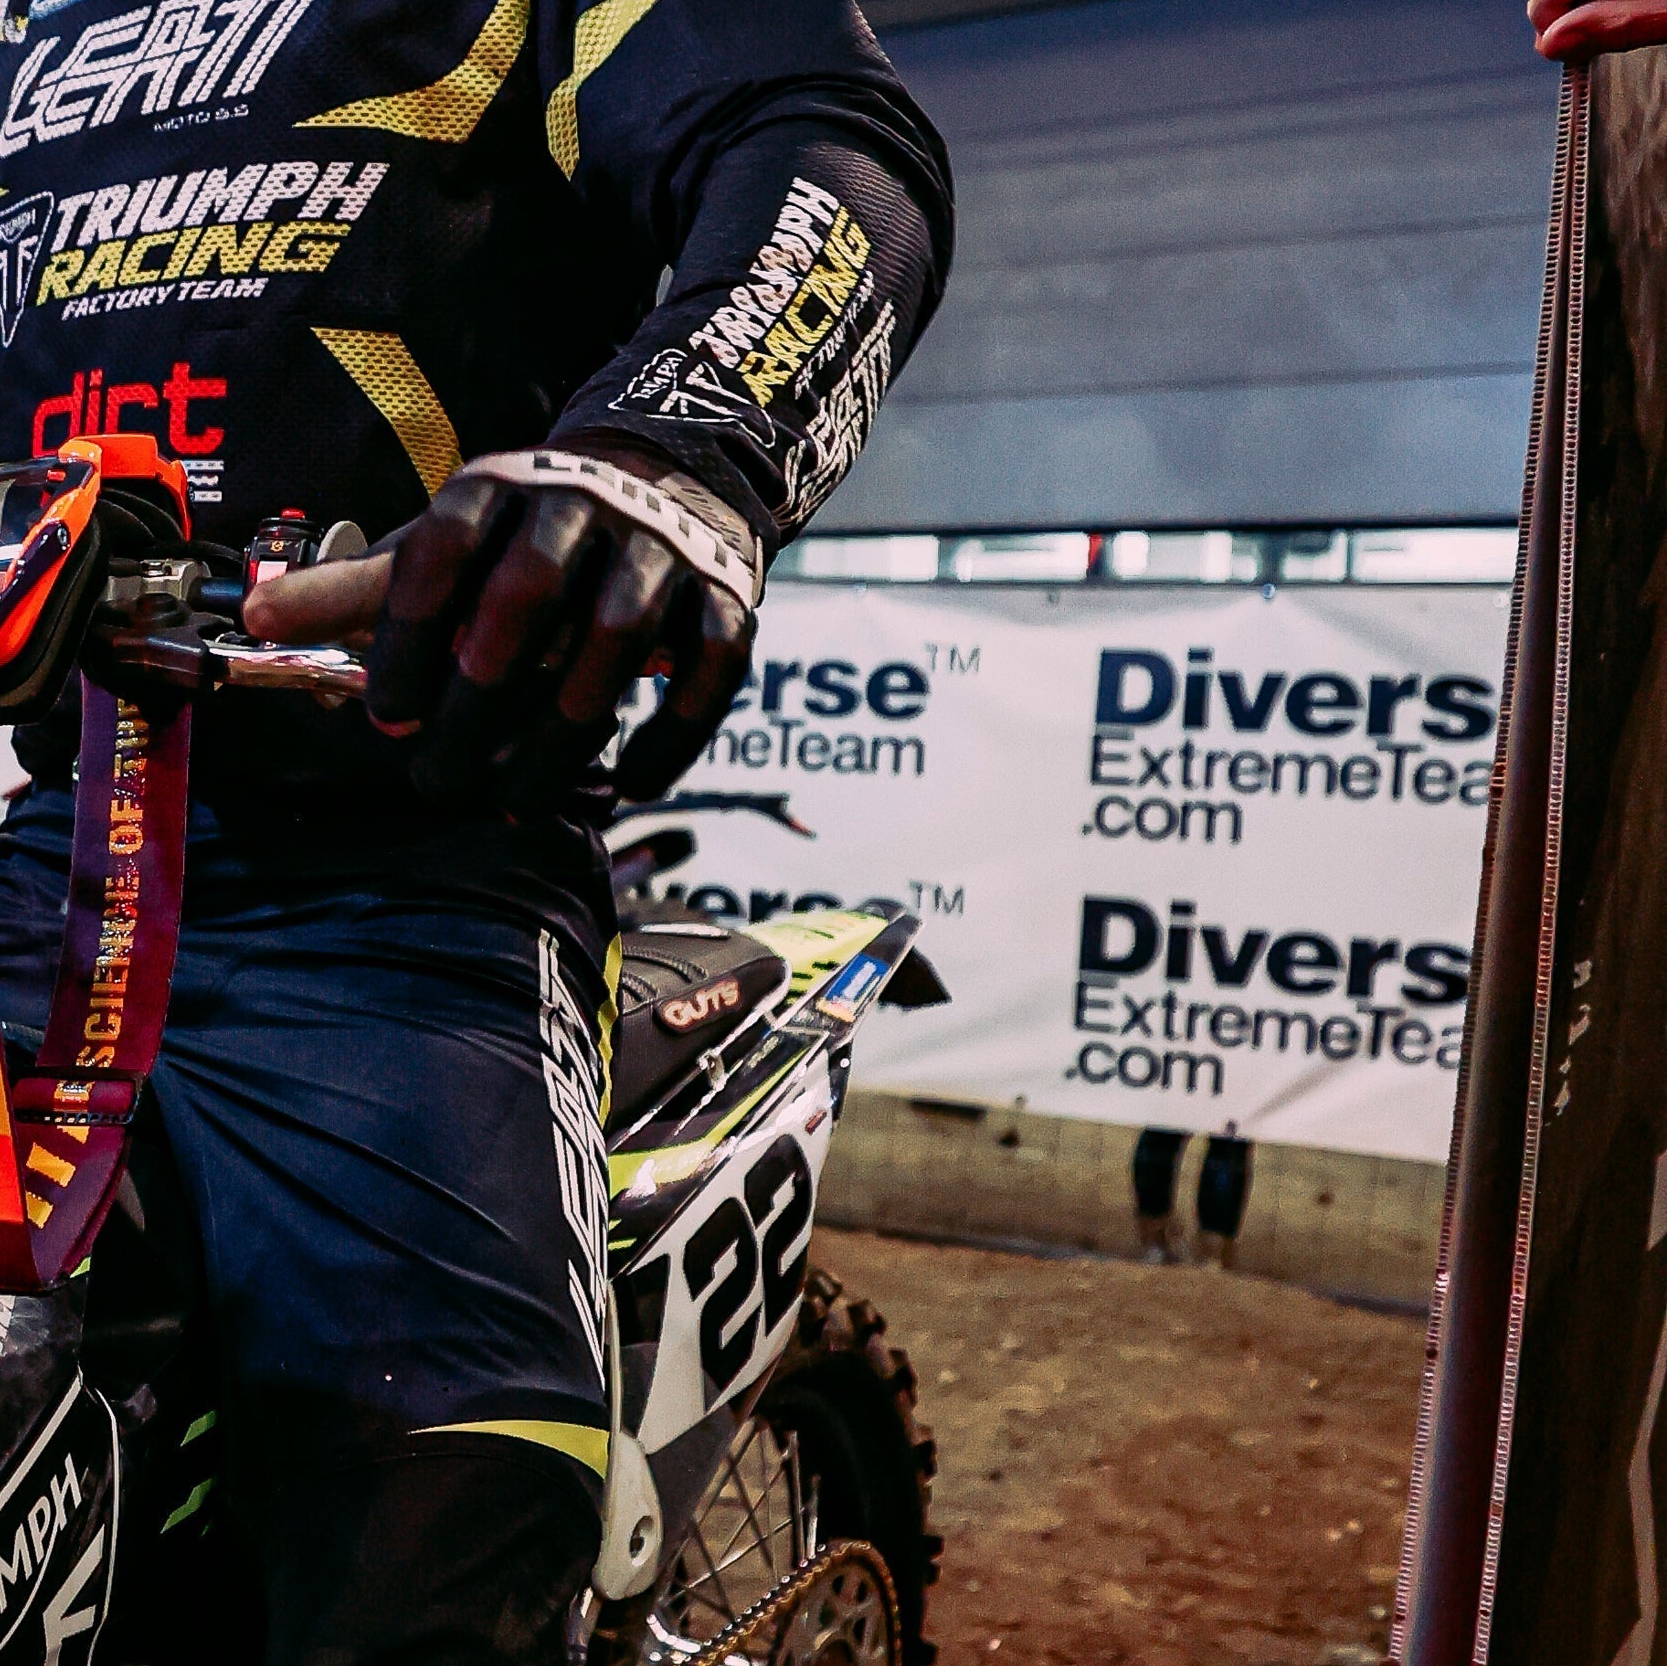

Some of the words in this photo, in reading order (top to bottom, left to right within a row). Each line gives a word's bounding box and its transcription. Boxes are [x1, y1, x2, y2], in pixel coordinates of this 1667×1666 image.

[51, 161, 391, 253] TRIUMPH
[36, 220, 352, 307] RACING
[61, 283, 176, 322] FACTORY
[176, 276, 269, 303] TEAM
[688, 175, 840, 369] TRIUMPH
[736, 205, 872, 410] RACING
[1095, 646, 1500, 742] Divers
[1090, 732, 1492, 807] ExtremeTea
[1081, 796, 1243, 845] .com
[1078, 894, 1469, 1008] Divers
[662, 978, 740, 1029] GUTS
[1073, 980, 1465, 1072] ExtremeTea
[1065, 1041, 1224, 1097] .com
